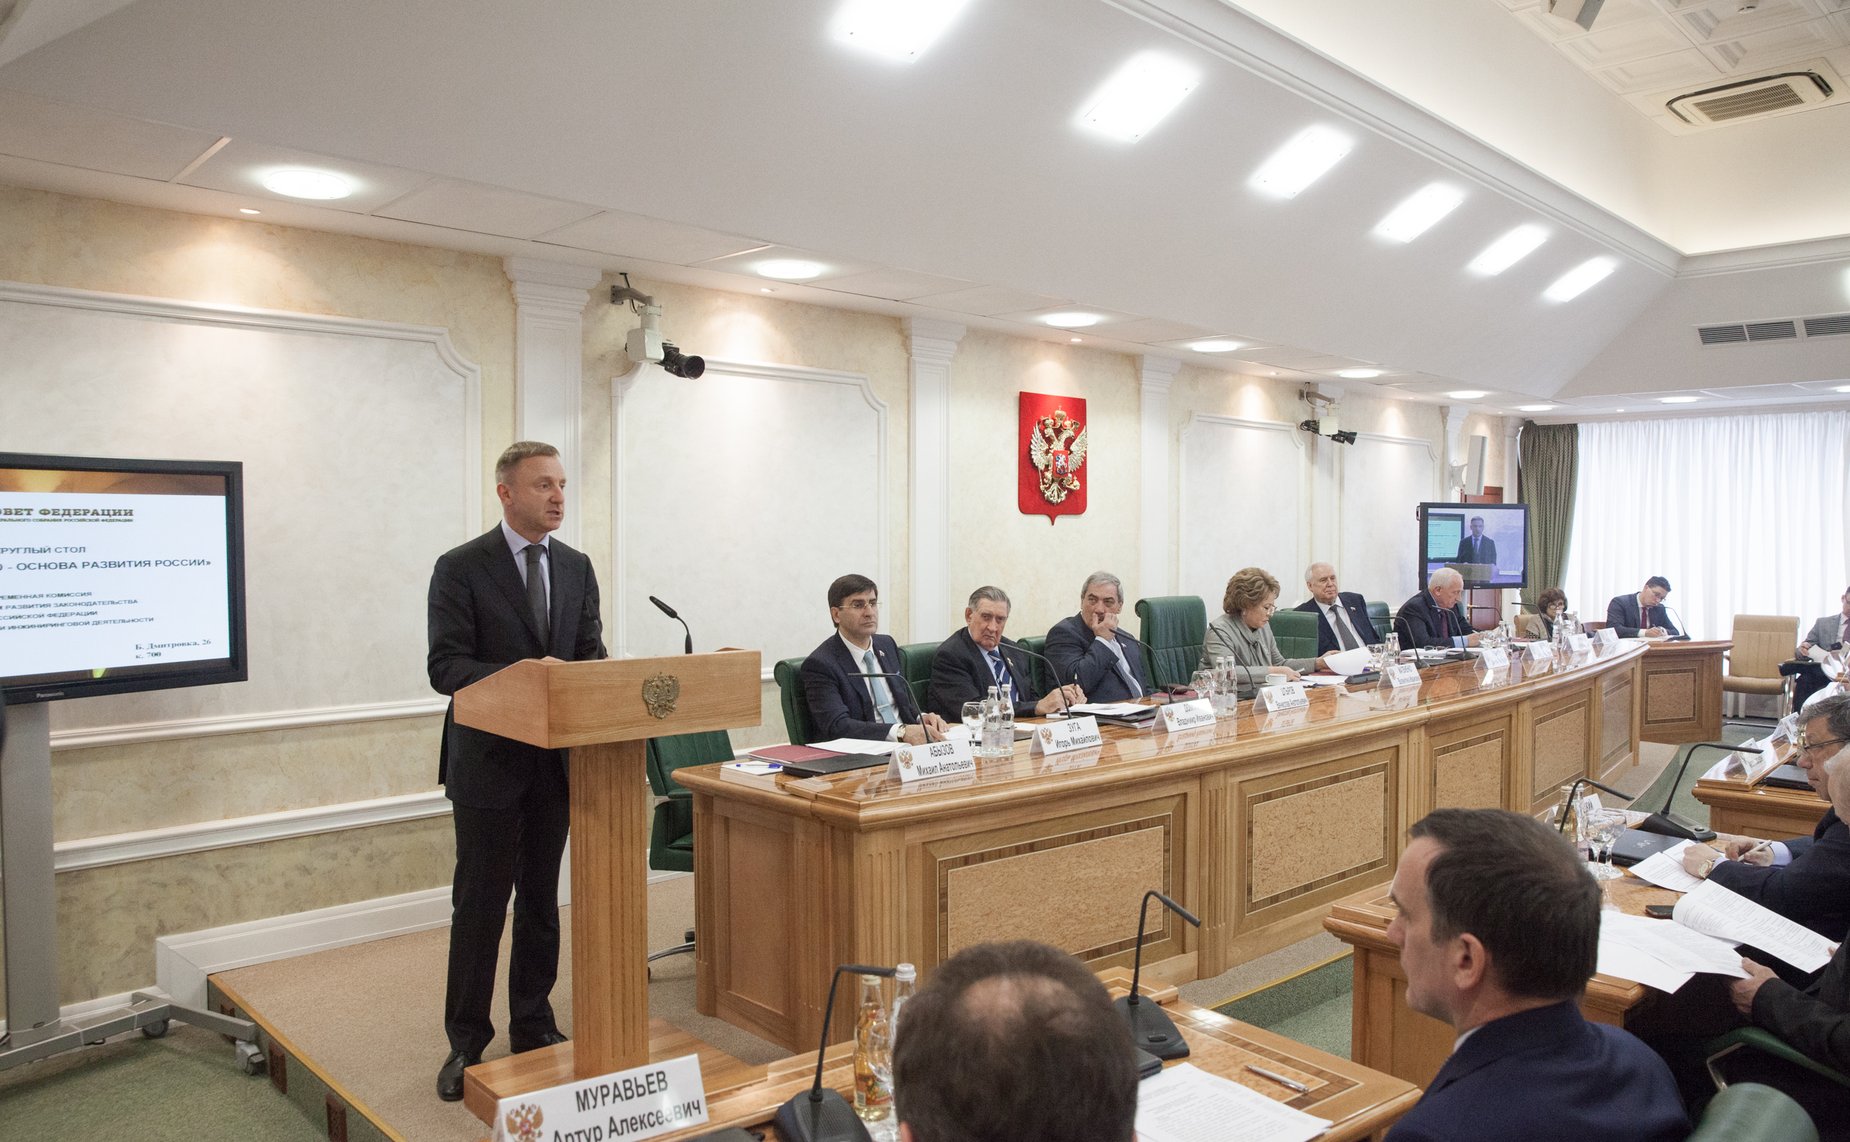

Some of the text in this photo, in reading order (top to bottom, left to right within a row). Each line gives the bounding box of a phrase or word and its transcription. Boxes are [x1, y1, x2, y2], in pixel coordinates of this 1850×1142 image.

[0, 508, 134, 517] ВЕТ ФЕДЕРАЦИИ
[0, 546, 51, 554] РУГЛЫЙ
[16, 562, 78, 571] ОСНОВА
[82, 560, 151, 569] РАЗВИТИЯ
[155, 558, 212, 567] РОССИИ»
[54, 599, 138, 608] ЗАКОНОДАТЕЛЬСТВА
[47, 610, 98, 618] ФЕДЕРАЦИИ
[8, 620, 90, 630] ИНЖИНИРИНГОВОЙ
[92, 616, 154, 626] ДЕЯТЕЛЬНОСТИ
[929, 743, 955, 758] АБЫЗОВ
[916, 759, 974, 777] Михаил Анатольевич
[575, 1070, 668, 1113] МУРАВЬЕВ
[608, 1099, 702, 1139] Алексеевич
